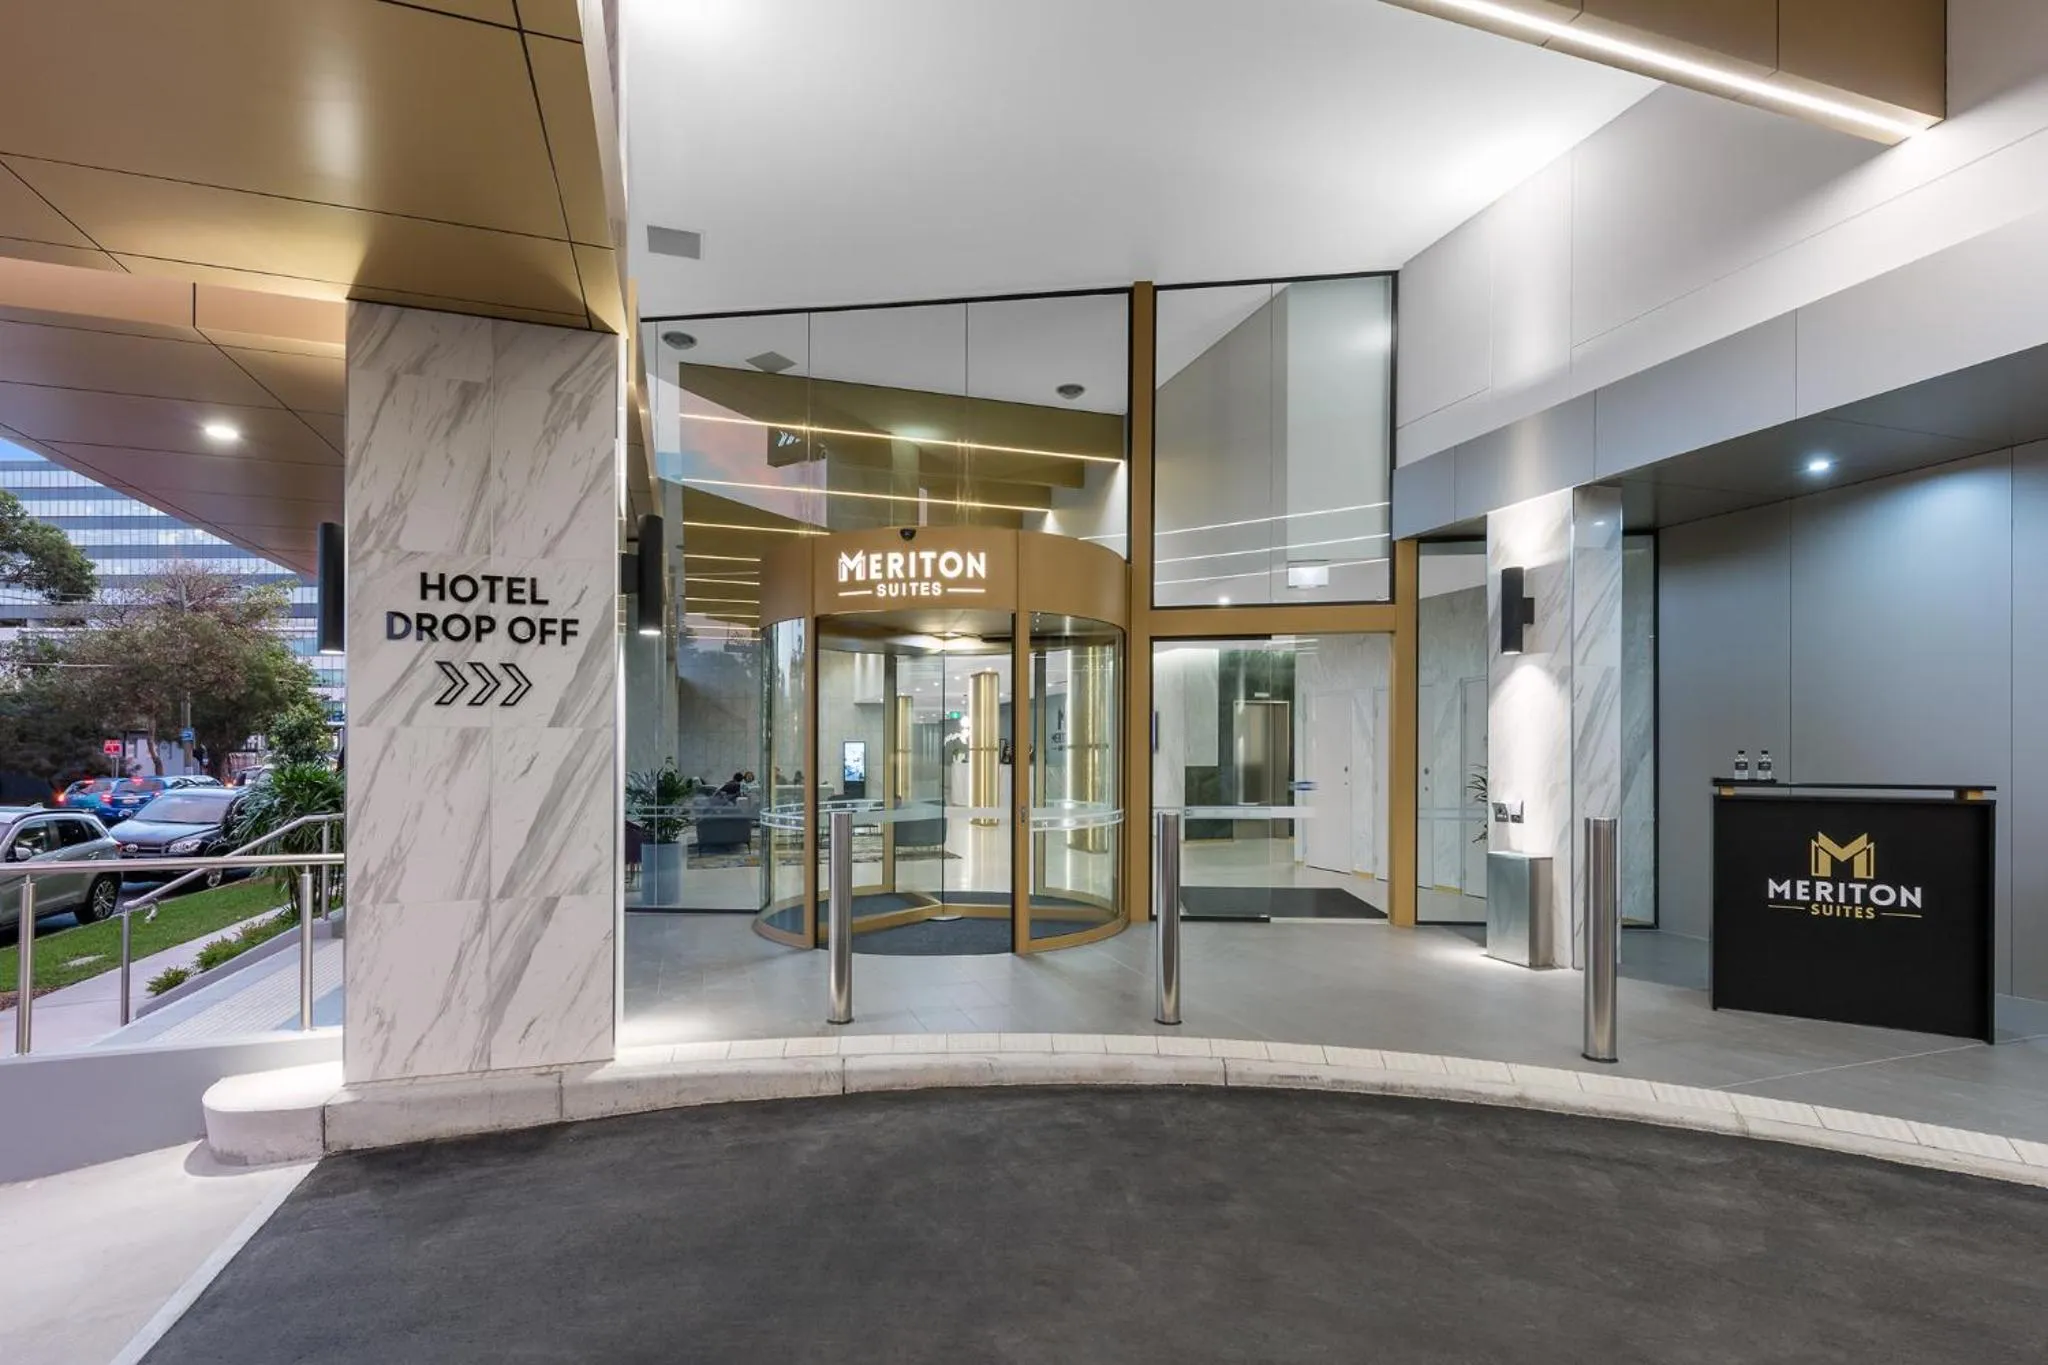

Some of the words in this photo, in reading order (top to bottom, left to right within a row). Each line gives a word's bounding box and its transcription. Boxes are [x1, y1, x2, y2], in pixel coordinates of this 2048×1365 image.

[838, 550, 986, 582] MERITON
[420, 572, 549, 605] HOTEL
[876, 582, 942, 597] SUITES
[386, 611, 496, 643] DROP
[508, 616, 579, 646] OFF
[1768, 878, 1922, 909] MERITON
[1811, 904, 1875, 919] SUITES
